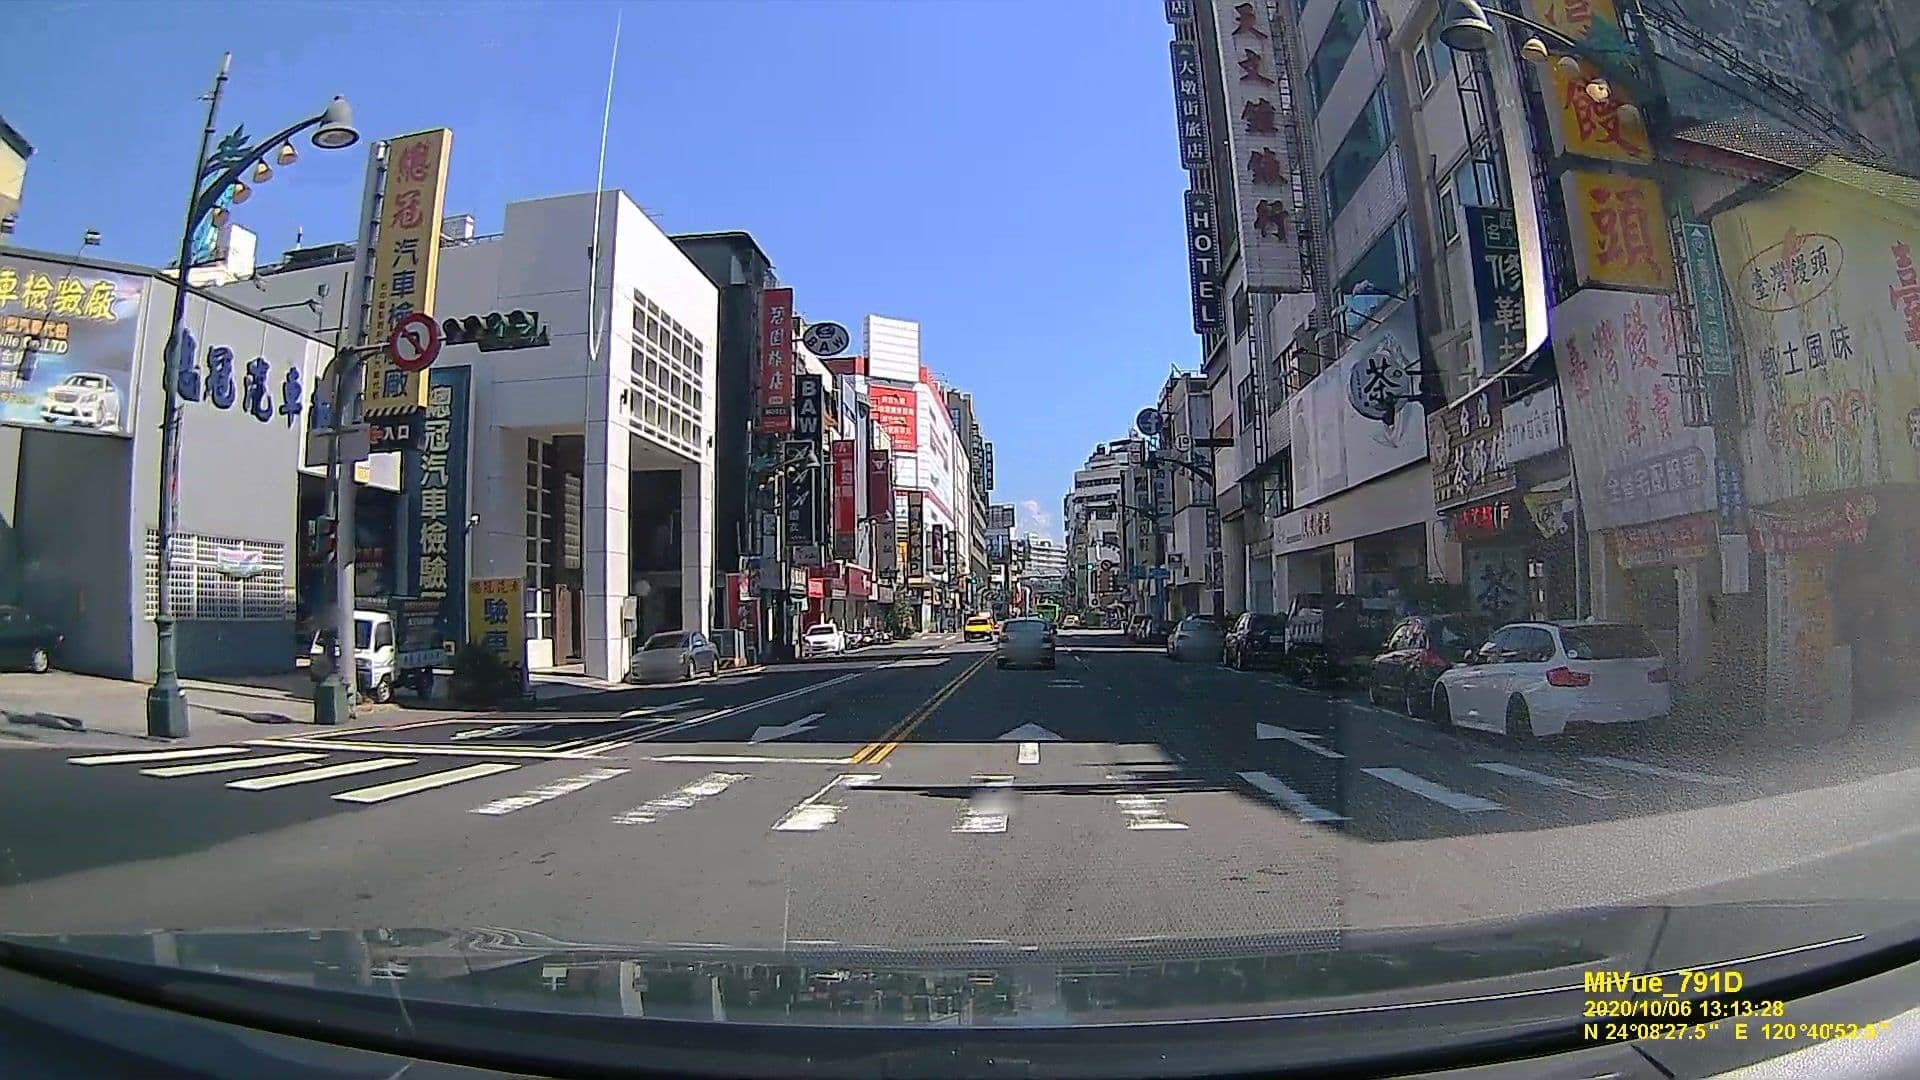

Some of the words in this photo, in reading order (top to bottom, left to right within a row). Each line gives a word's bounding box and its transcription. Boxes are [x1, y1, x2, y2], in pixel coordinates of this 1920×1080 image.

[1179, 59, 1204, 159] 大墩街旅店
[1193, 211, 1216, 323] HOTEL
[805, 333, 845, 353] BAW
[383, 424, 409, 440] 入口
[800, 380, 818, 434] BAW
